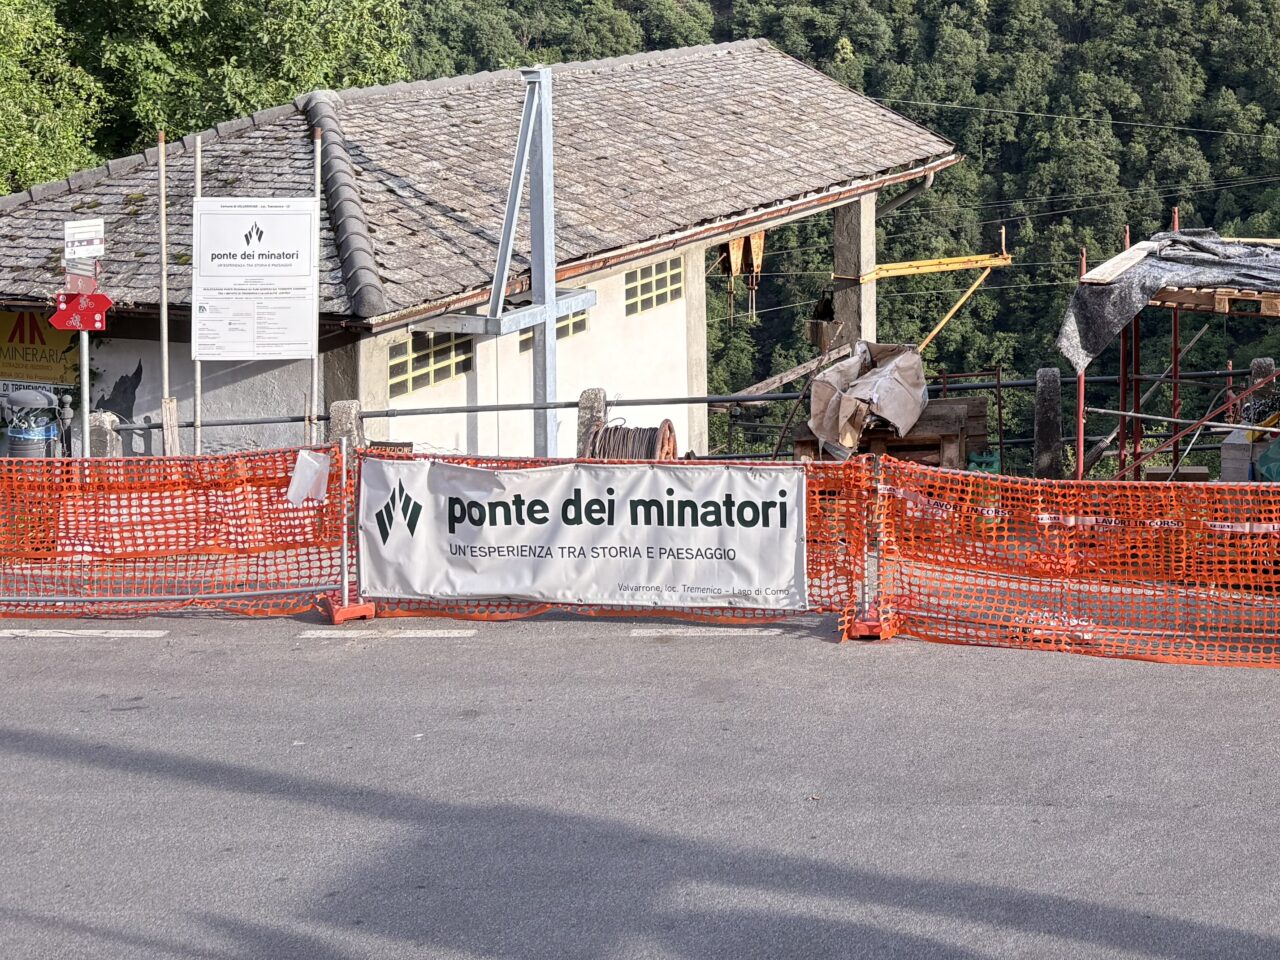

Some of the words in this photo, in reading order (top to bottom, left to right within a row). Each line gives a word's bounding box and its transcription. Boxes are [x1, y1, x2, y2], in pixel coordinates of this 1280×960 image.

[211, 251, 237, 262] ponte
[240, 251, 255, 260] dei
[258, 250, 299, 260] minatori
[448, 493, 549, 534] ponte
[561, 487, 615, 526] dei
[629, 487, 787, 528] minatori
[926, 499, 963, 514] LAVORI
[965, 506, 978, 515] IN
[979, 507, 1015, 516] CORSO
[1094, 517, 1129, 527] LAVORI
[1130, 519, 1143, 527] IN
[1144, 519, 1185, 528] CORSO
[450, 543, 553, 559] UN'ESPERIENZA
[558, 546, 586, 559] TRA
[590, 546, 642, 559] STORIA
[646, 547, 654, 559] E
[658, 547, 736, 561] PAESAGGIO
[617, 582, 663, 593] Valvarrone,
[683, 584, 722, 595] Tremenico
[732, 586, 752, 597] Lago
[754, 587, 762, 596] di
[764, 587, 790, 596] Como
